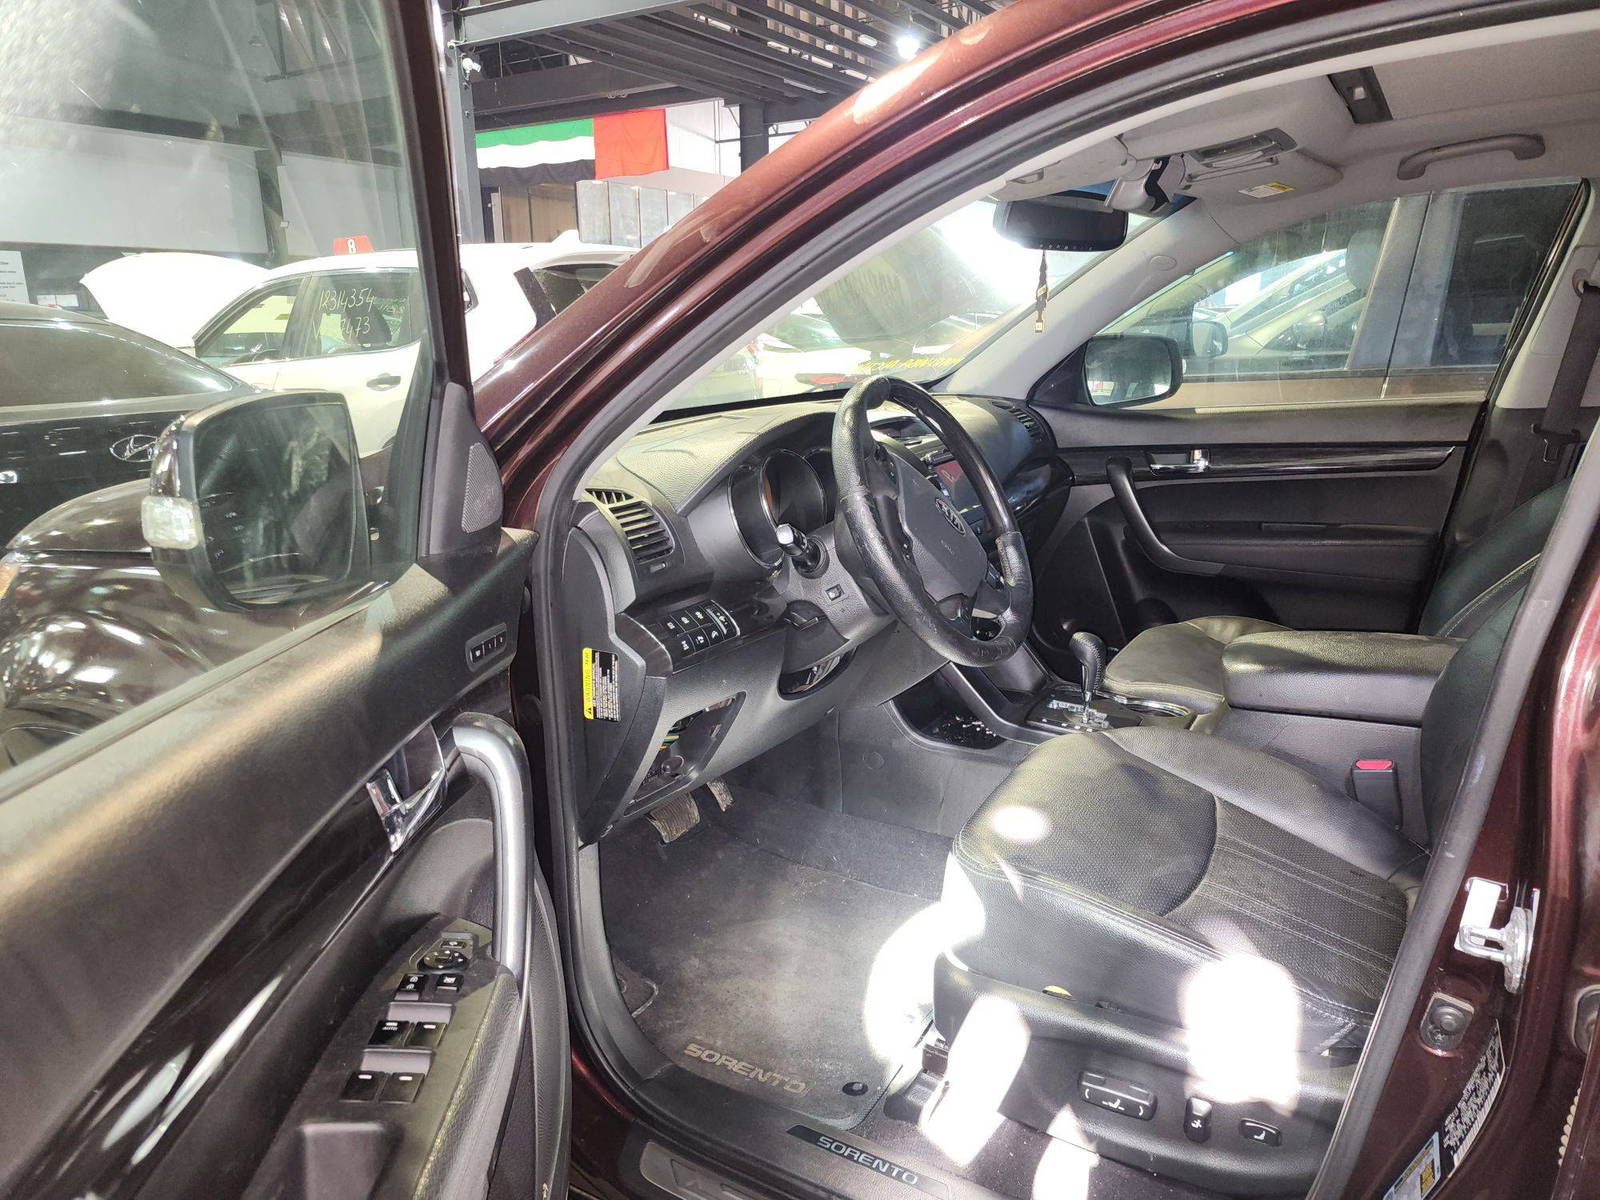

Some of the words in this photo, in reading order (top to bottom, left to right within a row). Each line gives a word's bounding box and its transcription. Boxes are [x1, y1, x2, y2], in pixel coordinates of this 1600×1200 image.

[347, 239, 357, 254] 8
[684, 1043, 808, 1095] SORENTO
[817, 1136, 918, 1185] SORENTO
